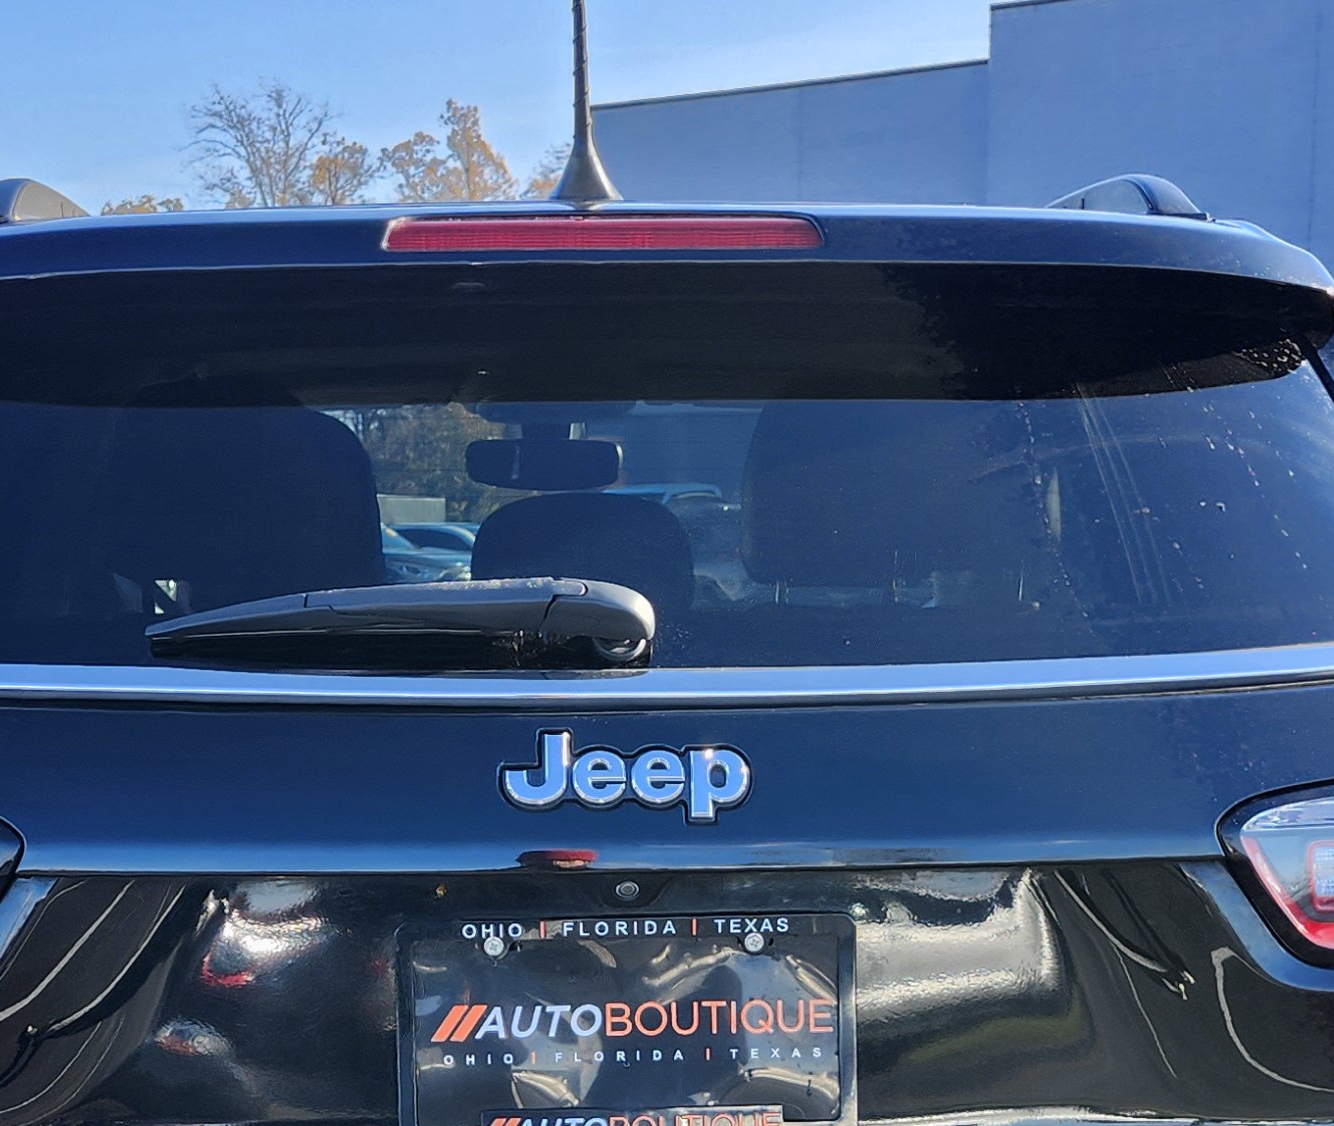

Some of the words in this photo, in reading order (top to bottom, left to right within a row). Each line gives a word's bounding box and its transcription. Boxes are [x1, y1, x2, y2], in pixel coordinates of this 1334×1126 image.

[501, 729, 751, 822] Jeep
[461, 922, 524, 940] OHIO
[562, 919, 677, 938] FLORIDA
[713, 917, 790, 934] TEXAS
[474, 998, 834, 1040] AUTOBOUTIQUE
[443, 1052, 514, 1066] OHIO
[554, 1049, 684, 1064] FLORIDA
[729, 1046, 822, 1060] TEXAS
